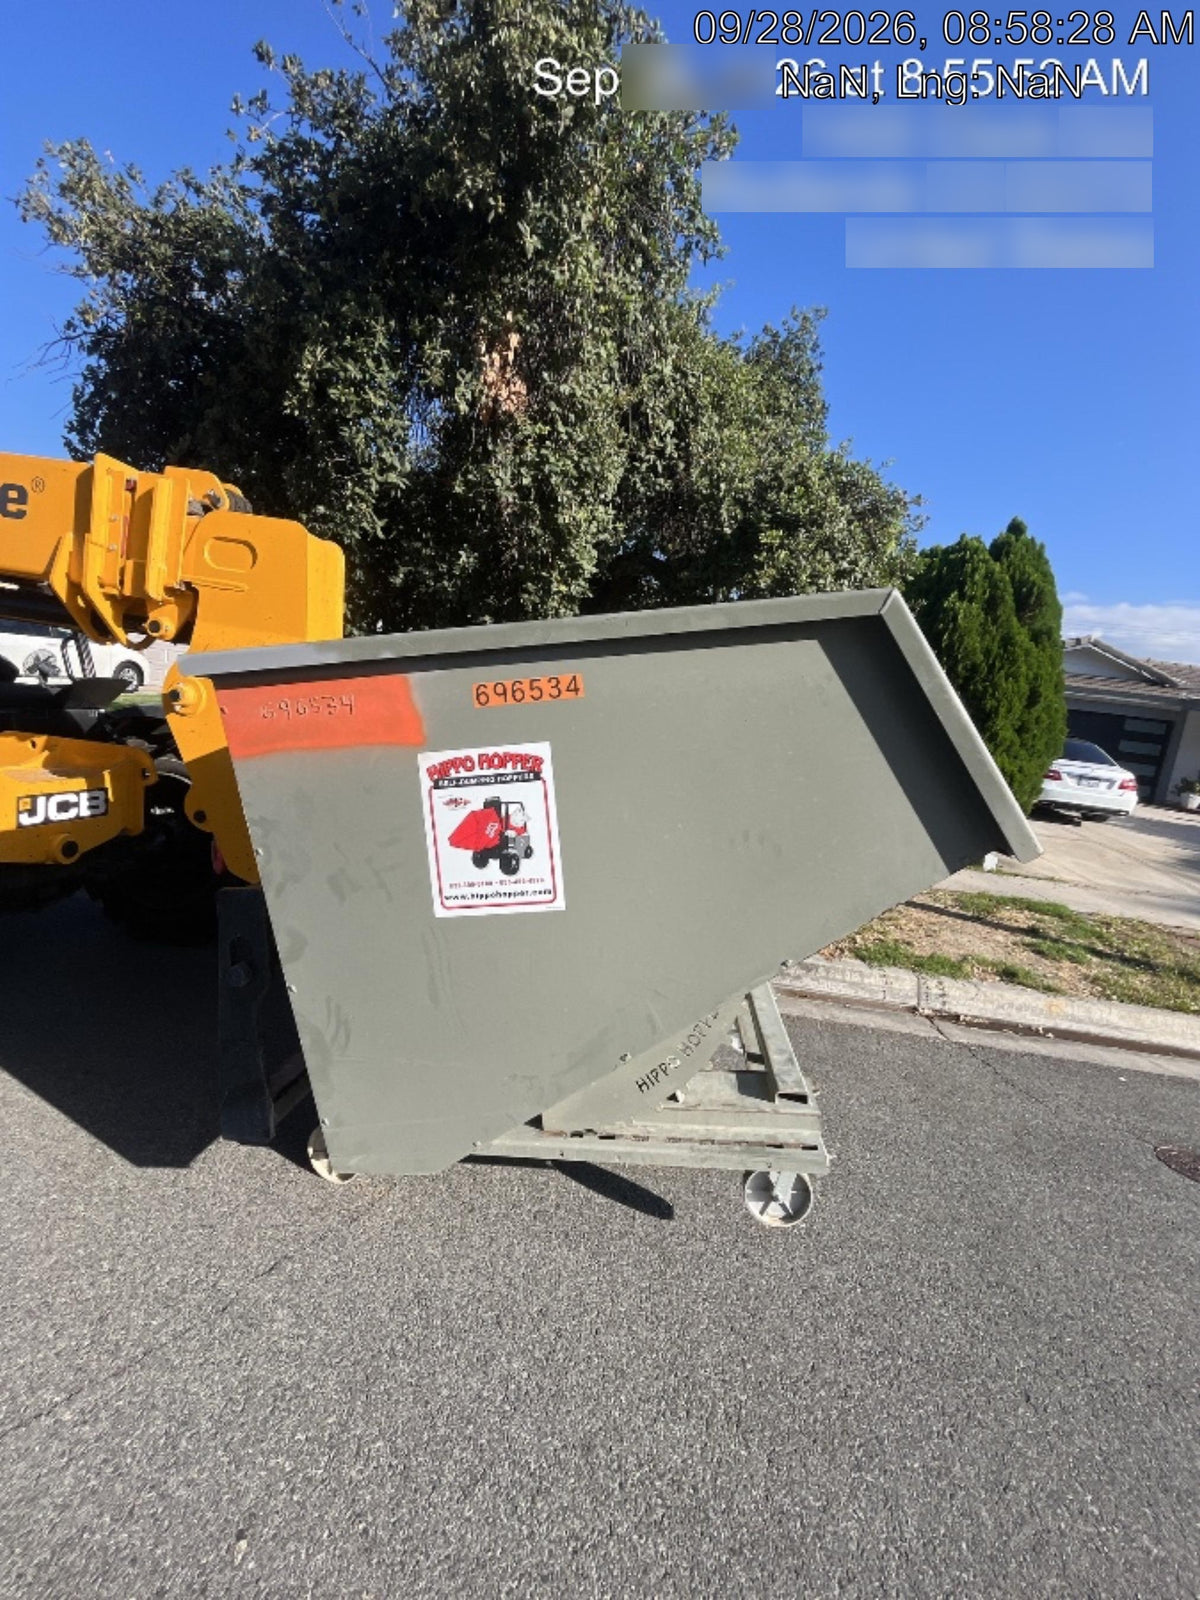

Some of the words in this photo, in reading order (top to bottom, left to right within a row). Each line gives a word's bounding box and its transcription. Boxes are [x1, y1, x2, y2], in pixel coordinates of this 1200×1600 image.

[476, 675, 580, 706] 696534
[426, 755, 475, 781] HIPPO
[478, 752, 544, 774] HOPPER
[18, 790, 107, 826] JCB
[635, 1055, 681, 1094] HIPPO
